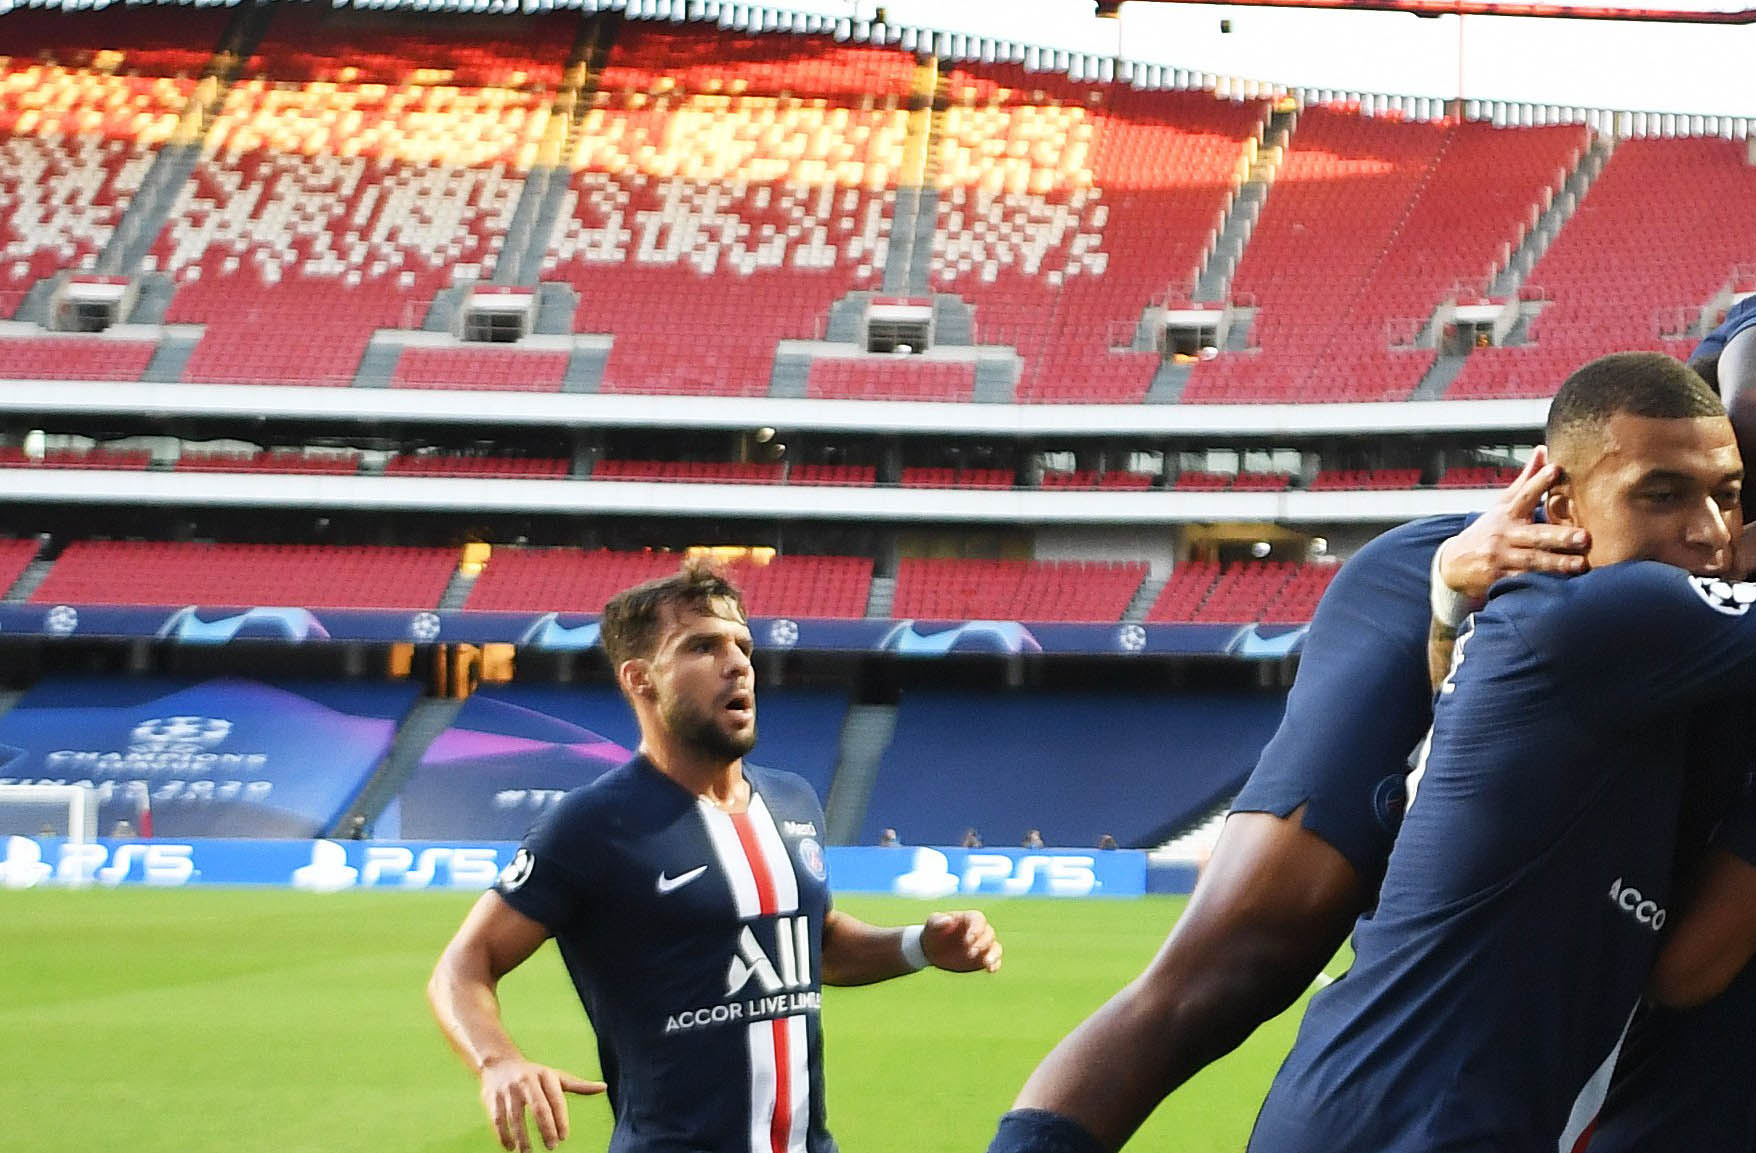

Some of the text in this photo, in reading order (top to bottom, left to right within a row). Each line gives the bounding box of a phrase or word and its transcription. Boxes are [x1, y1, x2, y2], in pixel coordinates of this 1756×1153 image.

[362, 848, 499, 888] PS5
[963, 855, 1096, 895] PS5
[1608, 877, 1666, 931] ACCO
[664, 1003, 743, 1033] ACCOR
[750, 995, 788, 1016] LIVE
